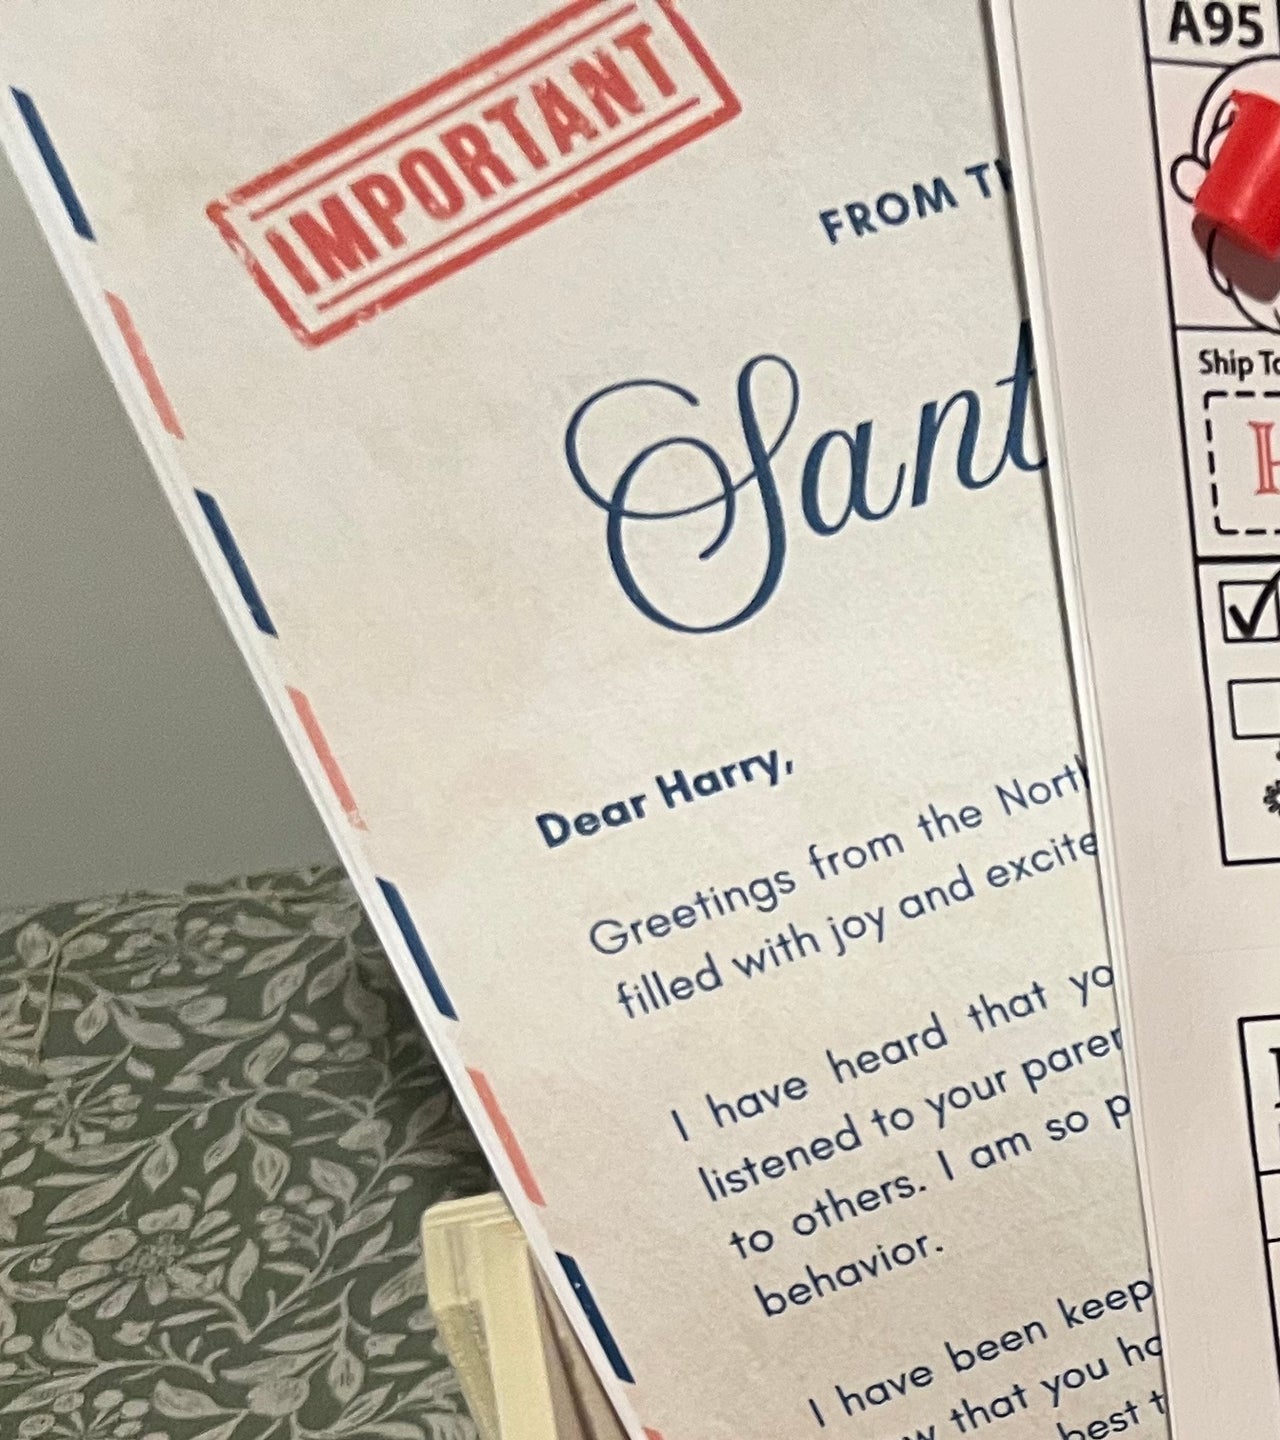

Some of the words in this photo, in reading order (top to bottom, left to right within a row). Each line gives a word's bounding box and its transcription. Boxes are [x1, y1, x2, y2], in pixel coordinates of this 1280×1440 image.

[1169, 0, 1264, 48] A95
[265, 24, 679, 295] IMPORTANT
[819, 165, 959, 245] FROM
[1198, 350, 1254, 380] Ship
[536, 794, 648, 848] Dear
[656, 750, 795, 806] Harry,
[590, 867, 797, 956] Greetings
[808, 830, 905, 881] from
[917, 803, 983, 842] the
[617, 953, 723, 1018] filled
[732, 923, 821, 980] with
[829, 902, 886, 957] joy
[899, 864, 975, 920] and
[671, 1109, 690, 1143] I
[706, 1076, 809, 1129] have
[826, 1012, 948, 1084] heard
[968, 981, 1047, 1033] that
[698, 1114, 863, 1202] listened
[872, 1106, 915, 1140] to
[926, 1071, 1009, 1130] your
[728, 1229, 774, 1259] to
[792, 1174, 927, 1237] others.
[936, 1149, 955, 1182] I
[970, 1132, 1032, 1170] am
[1047, 1110, 1089, 1142] so
[754, 1233, 945, 1317] behavior.
[807, 1398, 827, 1428] I
[835, 1364, 935, 1417] have
[945, 1318, 1049, 1373] been
[1057, 1280, 1154, 1328] keep
[949, 1384, 1029, 1434] that
[1041, 1357, 1111, 1408] you
